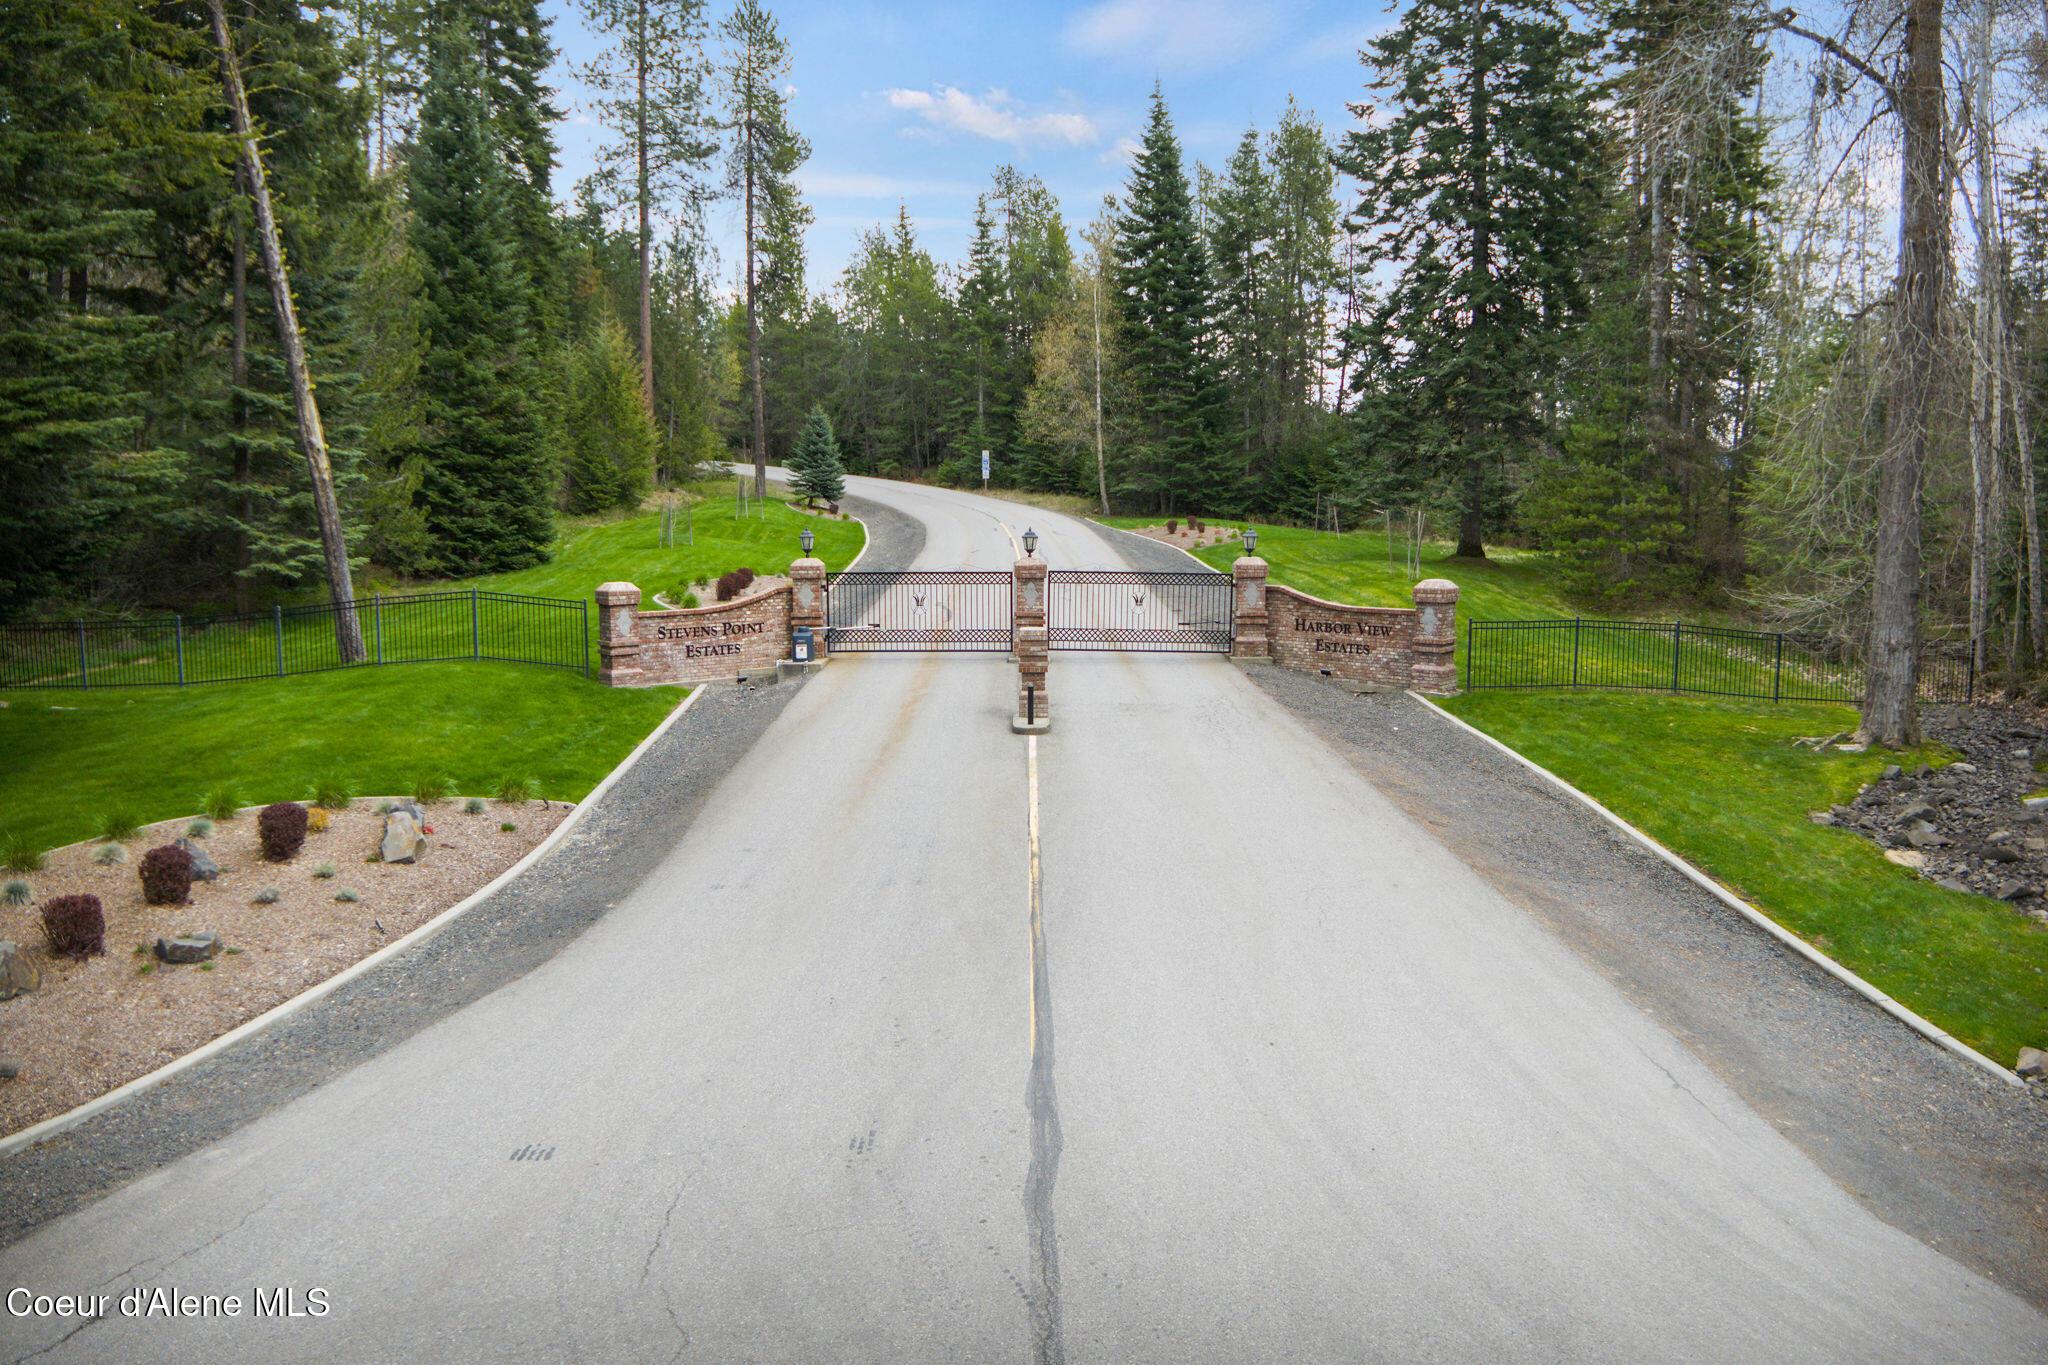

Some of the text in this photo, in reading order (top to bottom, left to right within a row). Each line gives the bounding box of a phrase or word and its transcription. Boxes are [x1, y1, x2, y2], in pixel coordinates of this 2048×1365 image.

[657, 622, 764, 639] STEVENS POINT
[1295, 618, 1392, 637] HARBOR VIEW
[685, 644, 741, 658] ESTATES
[1315, 639, 1370, 655] ESTATES
